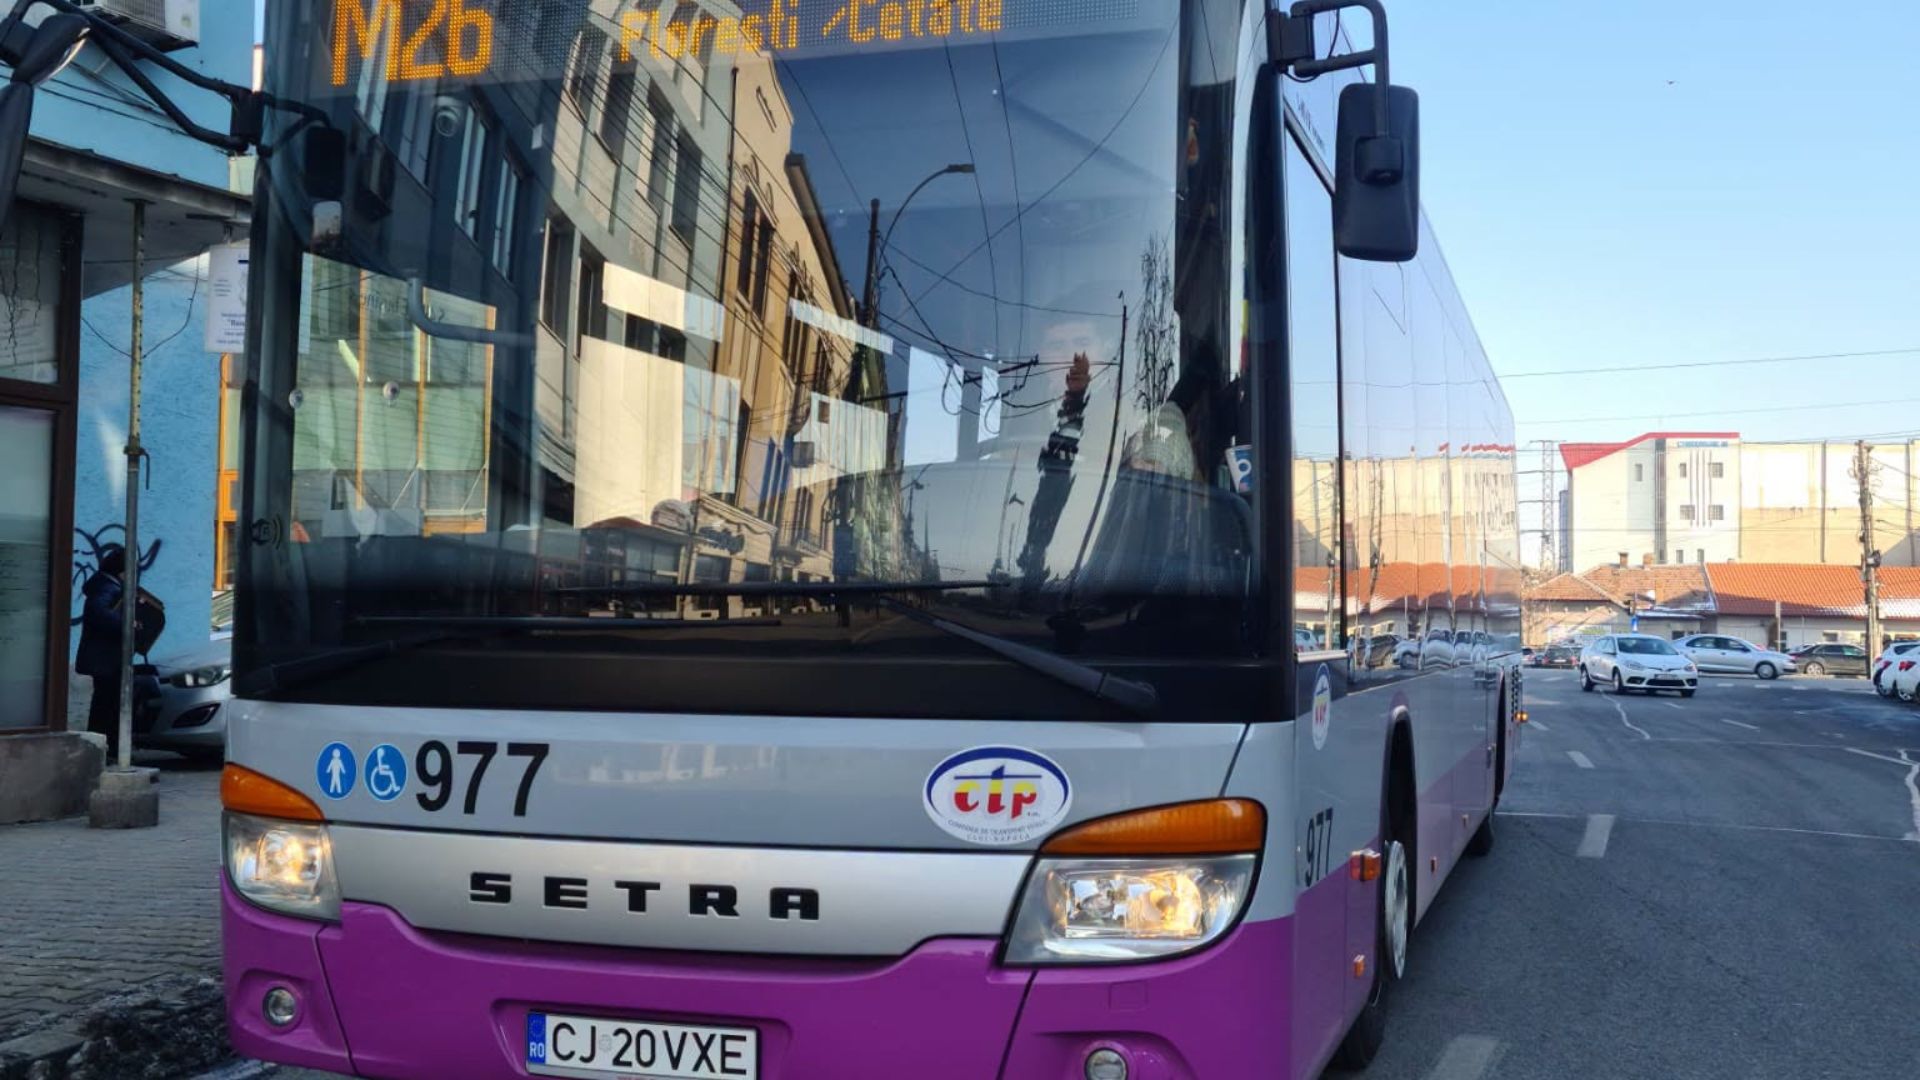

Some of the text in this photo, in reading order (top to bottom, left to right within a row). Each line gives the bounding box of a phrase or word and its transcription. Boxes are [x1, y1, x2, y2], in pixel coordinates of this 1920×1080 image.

[331, 0, 493, 87] M26
[619, 0, 799, 64] Floresti
[415, 739, 550, 817] 977
[1305, 807, 1334, 887] 977
[469, 871, 820, 921] SETRA
[529, 1042, 545, 1059] RO
[552, 1022, 597, 1063] CJ
